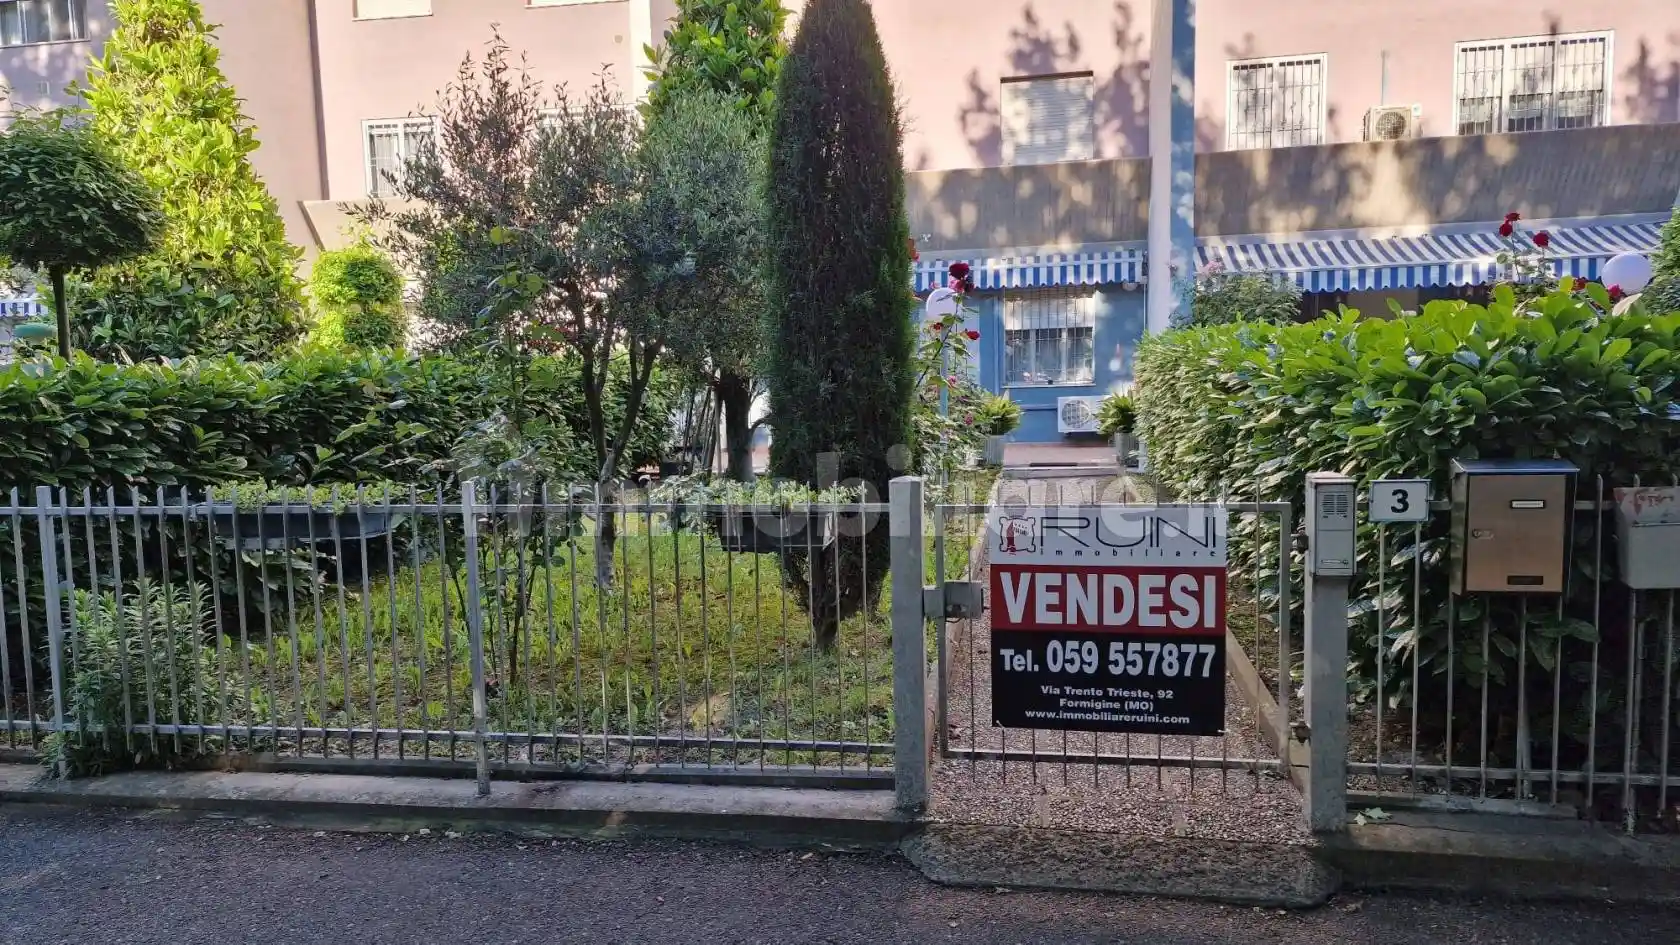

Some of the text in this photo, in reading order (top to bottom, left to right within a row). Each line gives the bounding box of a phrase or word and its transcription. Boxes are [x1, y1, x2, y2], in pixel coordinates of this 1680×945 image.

[1391, 489, 1409, 513] 3
[1040, 516, 1217, 548] RUINI
[1039, 548, 1217, 557] immobiliare
[999, 571, 1217, 629] VENDESI
[999, 639, 1216, 678] Tel. 059 557877
[1040, 685, 1174, 699] Via Trento Trieste, 92
[1059, 698, 1154, 712] Formigine (MO)
[1025, 710, 1190, 724] www.immobiliareruini.com
